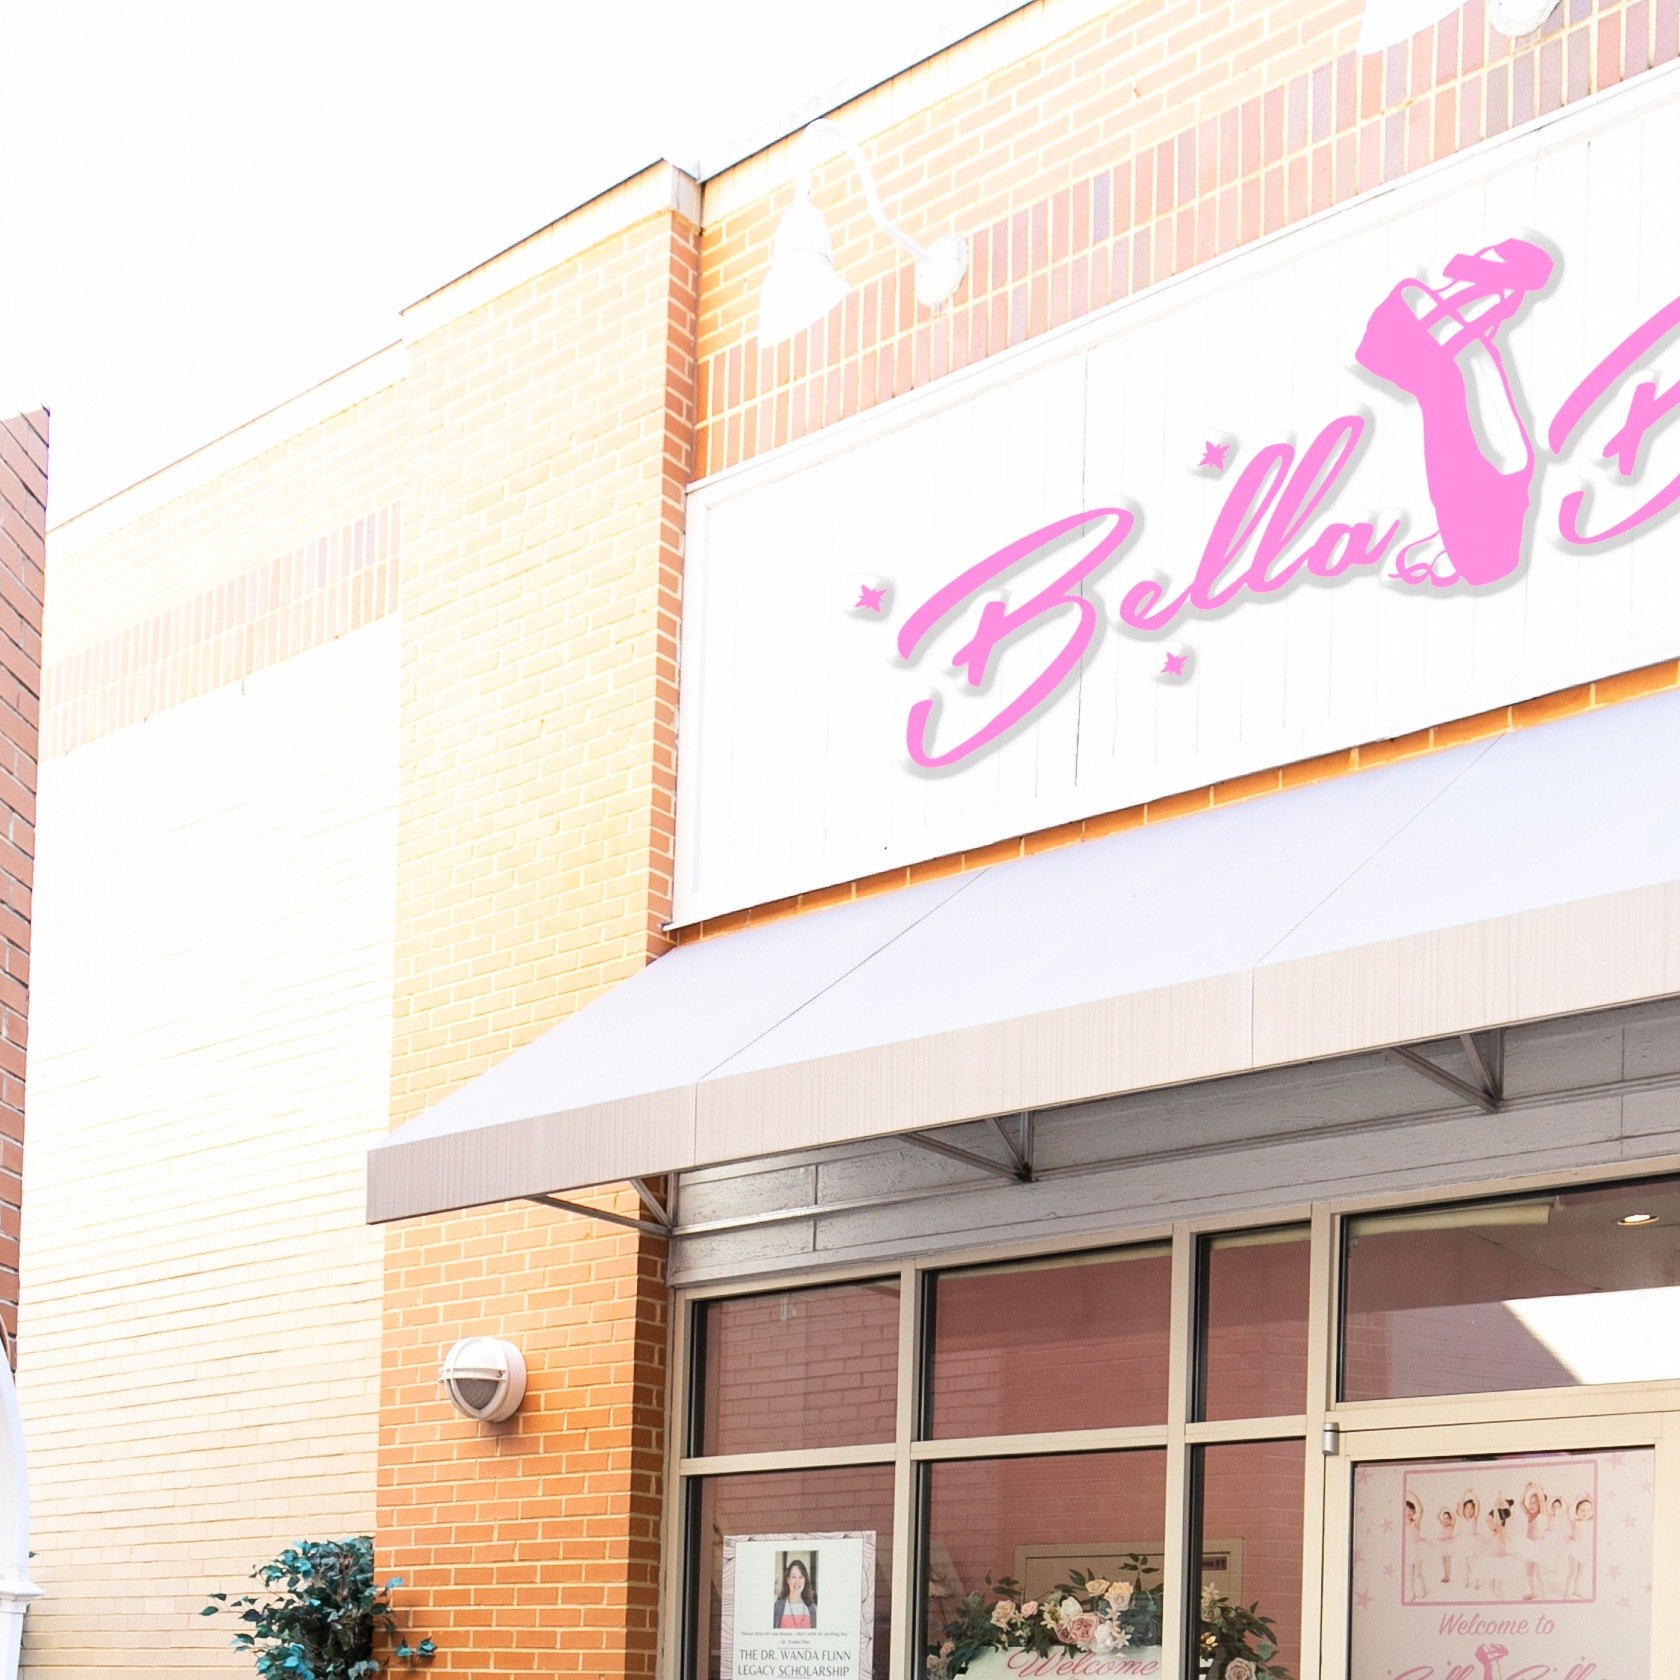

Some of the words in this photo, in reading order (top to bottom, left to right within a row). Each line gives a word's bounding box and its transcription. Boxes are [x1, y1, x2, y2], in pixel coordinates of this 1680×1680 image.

[897, 413, 1405, 768] Bella
[1438, 1613, 1529, 1636] Welcome
[1535, 1615, 1555, 1636] to
[739, 1649, 758, 1660] THE
[760, 1650, 777, 1661] DR.
[780, 1650, 819, 1661] WANDA
[822, 1650, 851, 1661] FLINN
[1007, 1650, 1159, 1678] Welcome
[738, 1665, 775, 1676] LEGACY
[778, 1665, 850, 1677] SCHOLARSHIP
